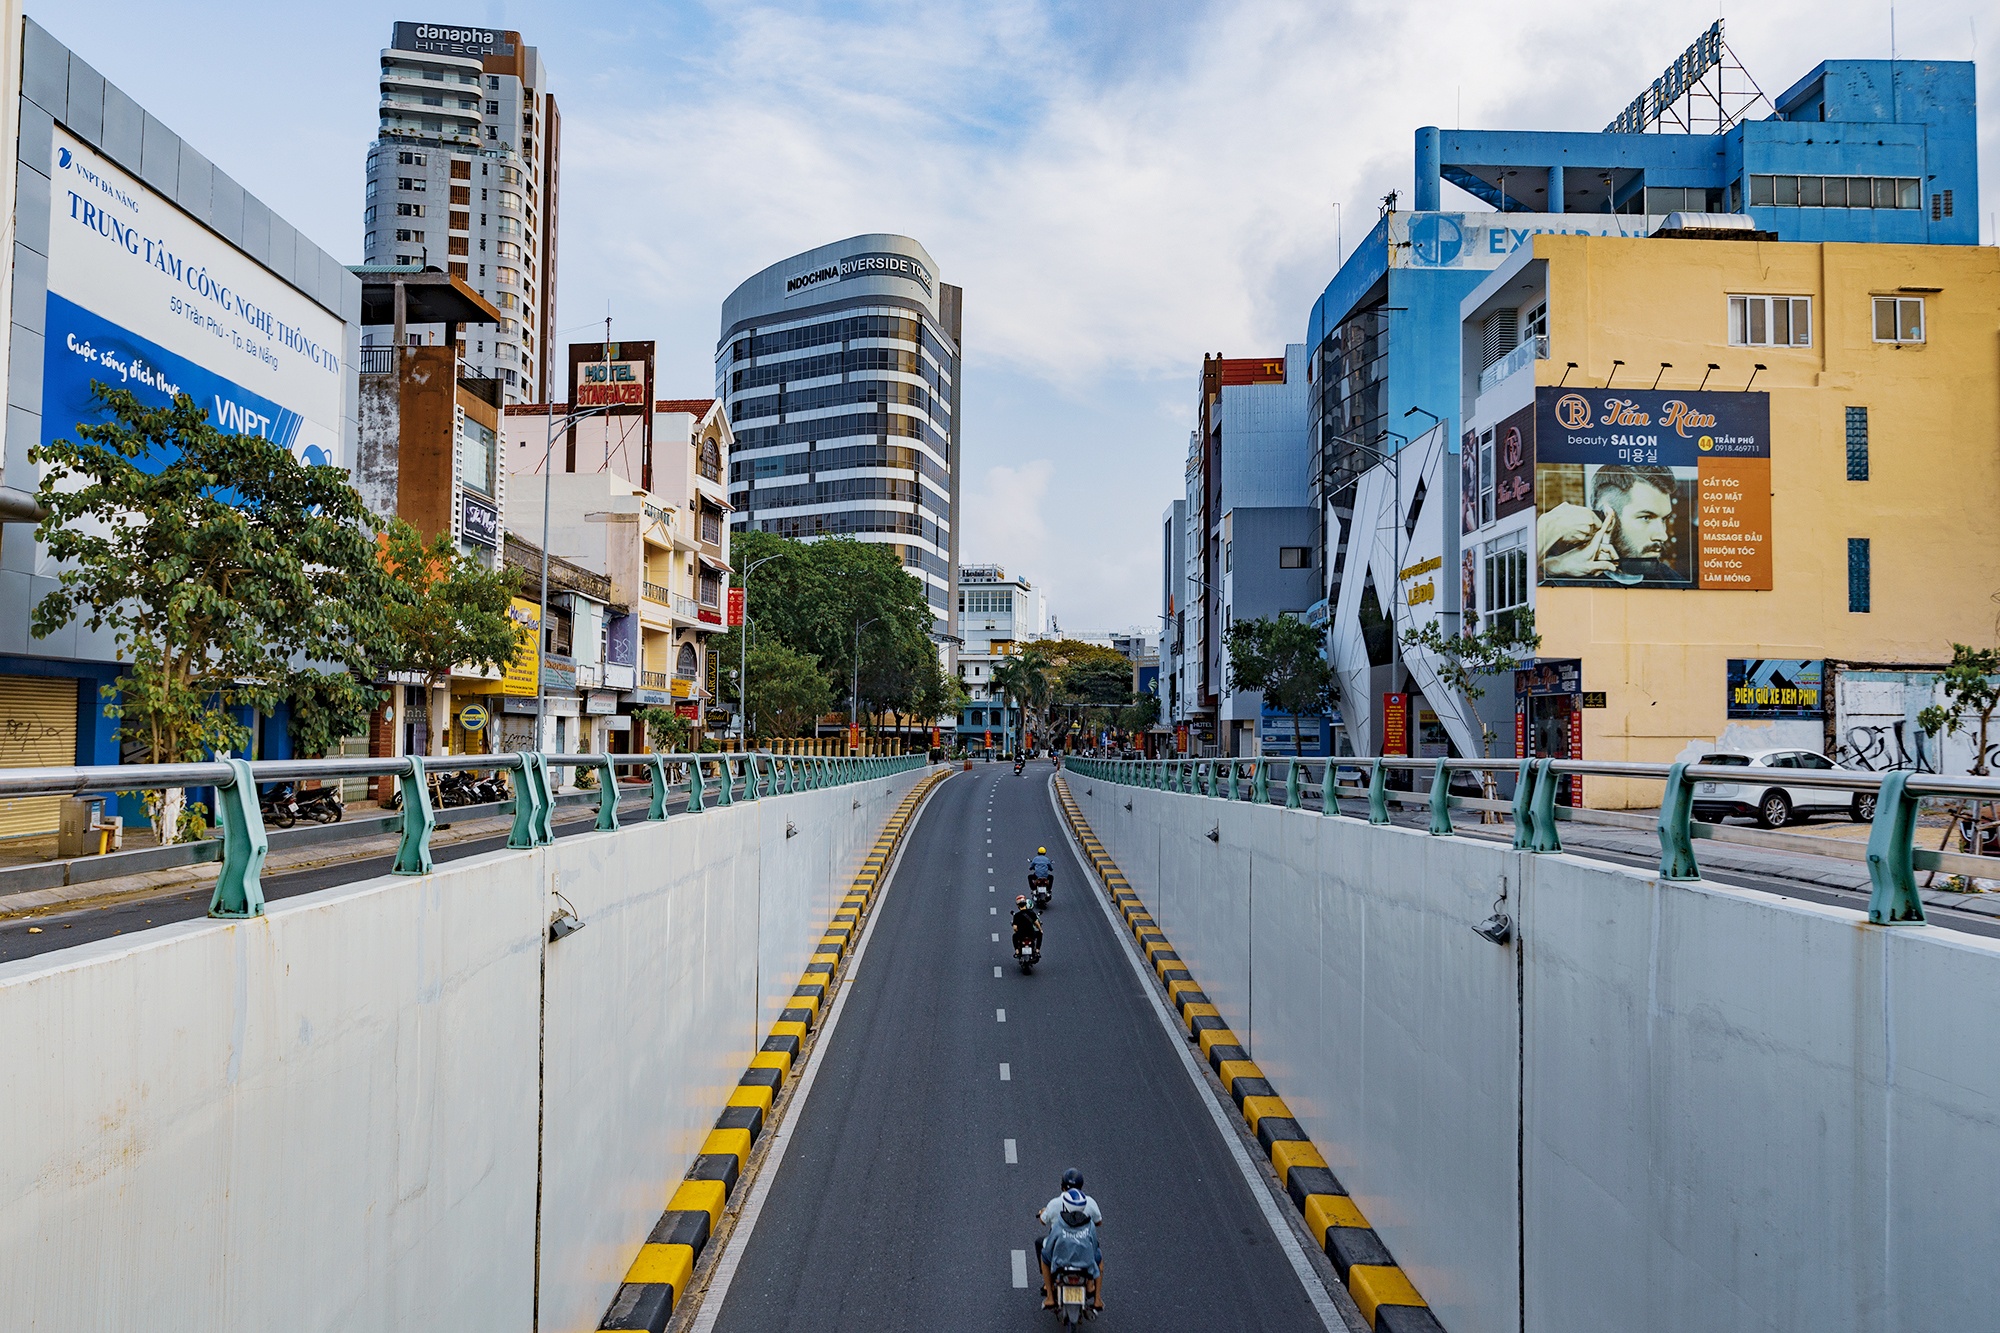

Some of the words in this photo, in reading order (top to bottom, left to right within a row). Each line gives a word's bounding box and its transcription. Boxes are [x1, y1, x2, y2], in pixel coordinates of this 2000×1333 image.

[416, 24, 494, 44] danapha
[415, 41, 494, 56] HITECH
[1652, 19, 1721, 118] DANANG
[75, 164, 101, 189] VNPT
[101, 179, 114, 199] ĐÀ
[787, 265, 839, 292] INDOCHINA
[840, 257, 908, 275] RIVERSIDE
[67, 190, 139, 255] TRUNG
[143, 237, 182, 282] TÂM
[186, 265, 232, 312] CÔNG
[235, 293, 275, 342] NGHỆ
[277, 319, 320, 368] THÔNG
[321, 345, 340, 376] TIN
[170, 295, 183, 315] 59
[184, 303, 205, 328] Trần
[206, 316, 224, 338] Phú
[231, 329, 244, 350] Tp.
[245, 338, 257, 357] Đà
[66, 332, 98, 363] Cuộc
[100, 350, 127, 383] sống
[129, 359, 155, 386] đích
[585, 364, 636, 382] HOTEL
[578, 383, 643, 405] STARGAZER
[214, 394, 270, 439] VNPT
[1600, 398, 1652, 427] Tấn
[1658, 399, 1717, 438] Rân
[1567, 435, 1608, 447] beauty
[1611, 434, 1658, 446] SALON
[1700, 438, 1711, 448] 44
[1738, 436, 1754, 445] PHÚ
[1618, 448, 1658, 463] 미용실
[1715, 445, 1760, 453] 0918.469711
[1703, 476, 1720, 487] CẮT
[1722, 476, 1740, 487] TÓC
[1703, 492, 1723, 502] CẠO
[1725, 491, 1742, 502] MẶT
[1722, 506, 1735, 514] TAI
[1703, 518, 1720, 529] GỘI
[1703, 533, 1742, 541] MASSAGE
[1704, 546, 1736, 556] NHUỘM
[1737, 546, 1755, 556] TÓC
[1704, 558, 1723, 568] UỐN
[1725, 559, 1743, 569] TÓC
[1704, 573, 1722, 582] LÀM
[1724, 573, 1751, 583] MÓNG
[1585, 693, 1603, 703] 44
[1734, 680, 1754, 705] ĐIỂM
[1770, 688, 1780, 705] XE
[1781, 688, 1797, 705] XEM
[1799, 688, 1818, 706] PHIM
